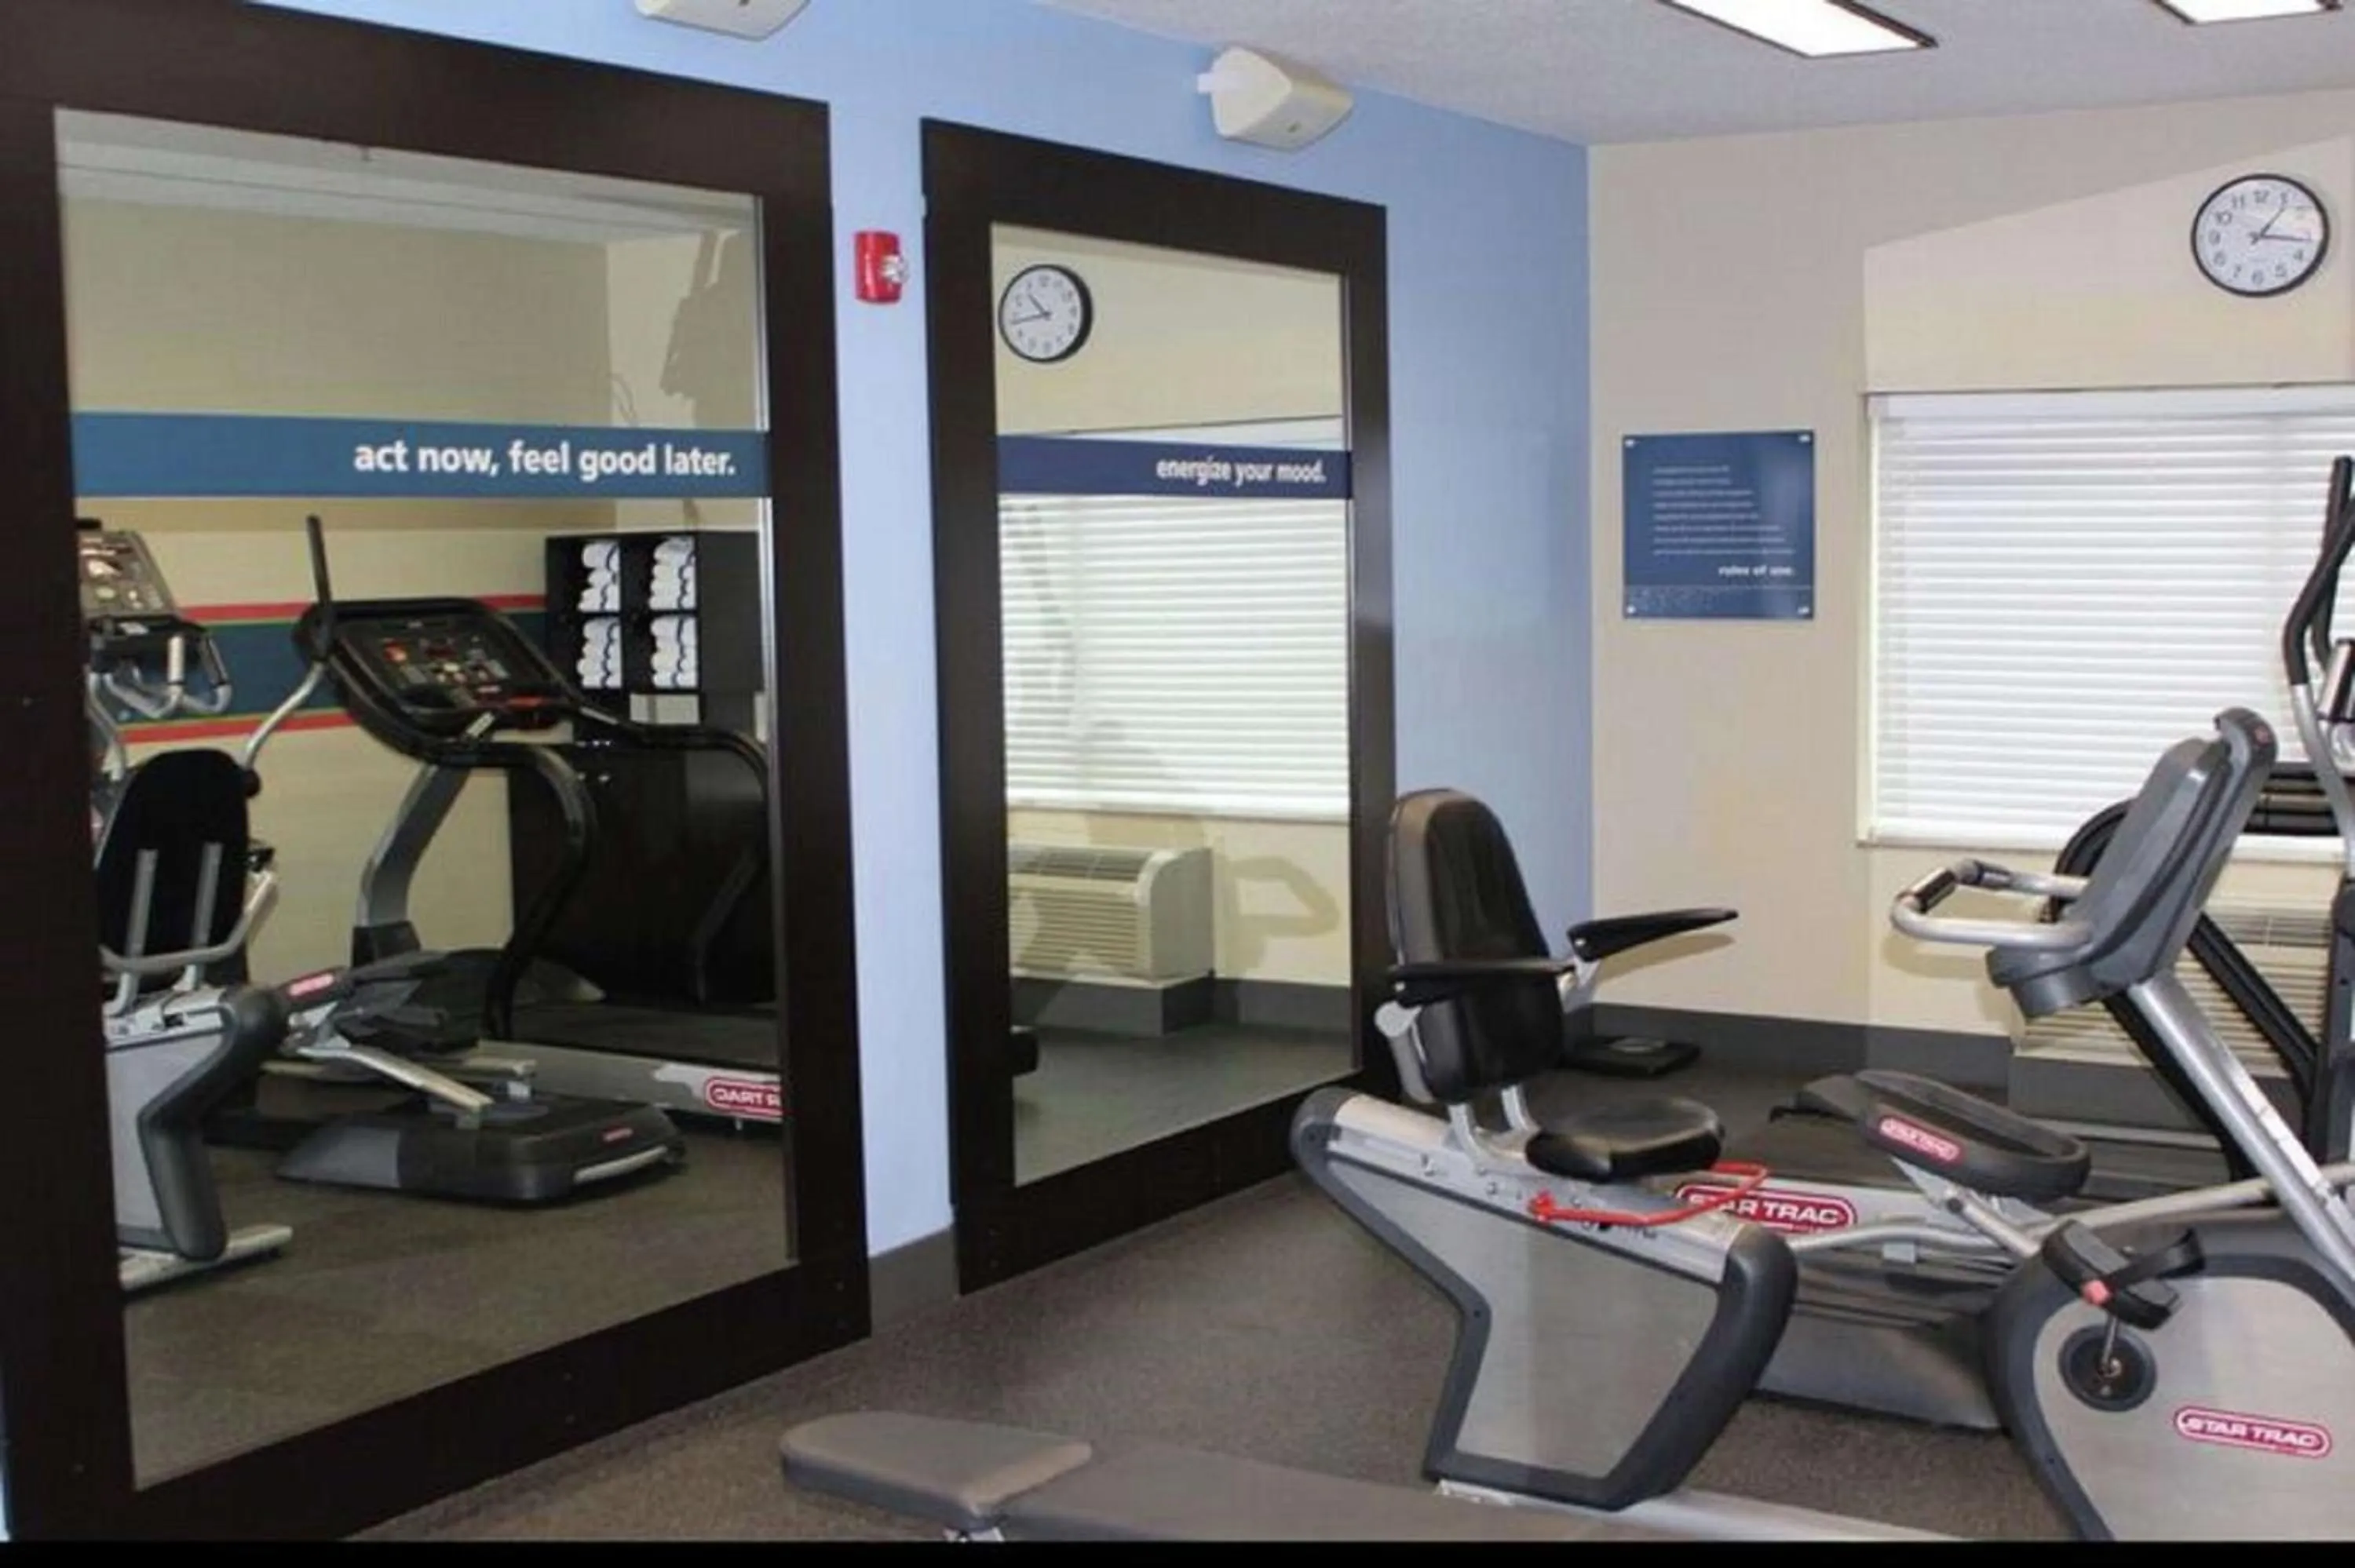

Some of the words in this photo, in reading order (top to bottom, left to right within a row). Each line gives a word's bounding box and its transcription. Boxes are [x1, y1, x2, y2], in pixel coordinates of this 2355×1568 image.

[354, 440, 410, 472] act
[418, 447, 498, 478] now,
[507, 439, 569, 472] feel
[579, 443, 655, 483] good
[665, 445, 736, 476] later.
[1156, 454, 1232, 487] energize
[1235, 463, 1273, 487] your
[1762, 1202, 1839, 1226] TRAC
[2185, 1417, 2247, 1437] STAR
[2250, 1426, 2317, 1448] TRAC
